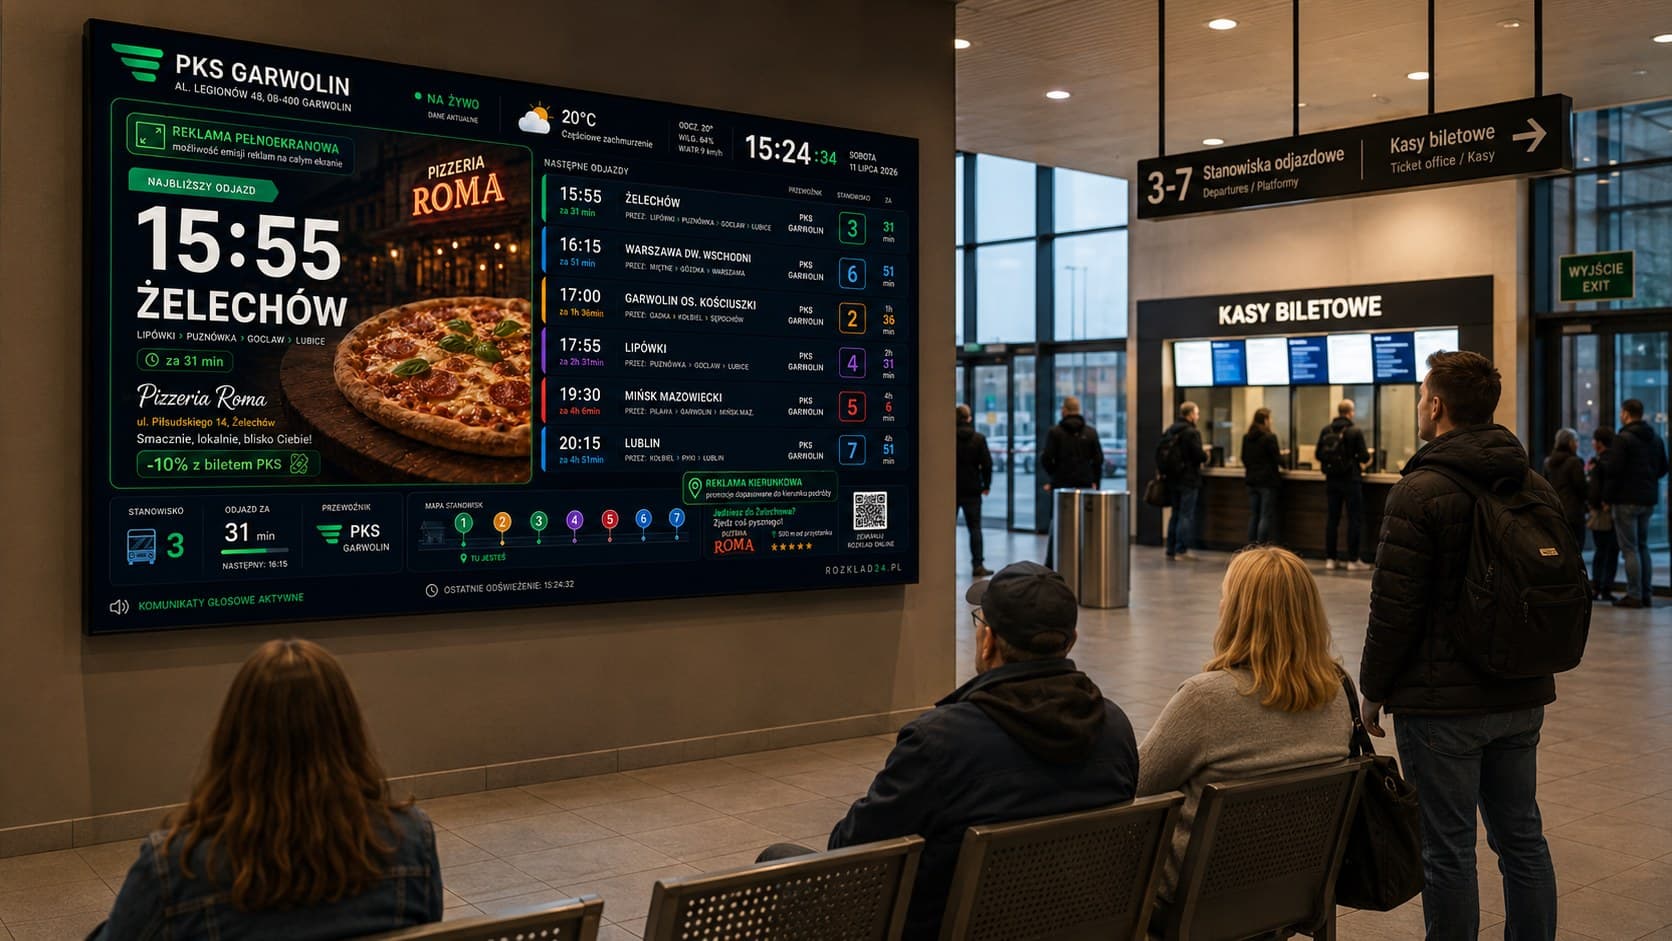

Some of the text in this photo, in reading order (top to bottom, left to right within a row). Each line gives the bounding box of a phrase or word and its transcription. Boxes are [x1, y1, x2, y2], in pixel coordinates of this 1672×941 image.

[176, 54, 350, 96] PKS GARWOLIN
[175, 82, 351, 112] AL. LEGIONÓW 48, 08-400 GARWOLIN
[427, 94, 479, 110] NA ŻYWO
[562, 110, 596, 127] 20°C
[173, 126, 339, 154] REKLAMA PEŁNOEKRANOWA
[562, 130, 653, 148] Częściowe zachmurzenie
[1390, 124, 1495, 156] Kasy biletowe
[221, 147, 245, 159] emisji
[247, 149, 275, 160] reklam
[277, 153, 287, 162] na
[849, 151, 876, 162] SOBOTA
[1390, 158, 1422, 174] Ticket
[1425, 153, 1456, 169] office
[1467, 148, 1495, 166] Kasy
[428, 155, 485, 179] PIZZERIA
[544, 159, 628, 175] NASTĘPNE ODJAZDY
[850, 163, 898, 177] 11 LIPCA 2026
[1203, 148, 1344, 181] Stanowiska odjazdowe
[148, 177, 256, 195] NAJBLIŻSZY ODJAZD
[1147, 166, 1193, 204] 3-7
[1203, 182, 1249, 199] Departures
[1257, 176, 1299, 192] Platformy
[412, 173, 505, 216] ROMA
[560, 186, 680, 208] 15:55 ŻELECHÓW
[560, 207, 595, 217] za 31 min
[800, 214, 812, 222] PKS
[848, 220, 857, 237] 3
[883, 222, 894, 232] 31
[137, 206, 341, 280] 15:55
[560, 238, 751, 263] 16:15 WARSZAWA DW. WSCHODNI
[570, 258, 579, 267] 51
[581, 259, 595, 268] min
[800, 261, 812, 269] PKS
[1569, 261, 1624, 278] WYJŚCIE
[848, 266, 857, 282] 6
[883, 266, 894, 276] 51
[1583, 280, 1610, 292] EXIT
[137, 280, 347, 327] ŻELECHÓW
[560, 288, 756, 310] 17:00 GARWOLIN OS. KOŚCIUSZKI
[800, 306, 813, 314] PKS
[1219, 295, 1382, 325] KASY BILETOWE
[848, 310, 857, 327] 2
[883, 315, 895, 325] 36
[137, 329, 175, 340] LIPÓWKI
[296, 336, 325, 346] LUBICE
[560, 338, 667, 353] 17:55 LIPÓWKI
[166, 356, 224, 367] za 31 min
[848, 355, 858, 372] 4
[883, 359, 894, 368] 31
[137, 382, 267, 410] Pizzeria Roma
[560, 387, 722, 402] 19:30 MIŃSK MAZOWIECKI
[848, 399, 857, 415] 5
[885, 402, 892, 412] 6
[137, 416, 275, 429] ul. Piłsudskiego 14, Żelechów
[137, 434, 312, 445] Smacznie, lokalnie, blisko Ciebie!
[560, 436, 660, 450] 20:15 LUBLIN
[848, 442, 857, 458] 7
[883, 444, 894, 454] 51
[147, 457, 282, 471] -10% z biletem PKS
[706, 478, 802, 487] REKLAMA KIERUNKOWA
[128, 507, 184, 516] STANOWISKO
[225, 506, 258, 514] ODJAZD
[322, 503, 370, 512] PRZEWOŹNIK
[461, 518, 465, 527] 1
[500, 517, 506, 527] 2
[536, 516, 542, 526] 3
[572, 516, 578, 525] 4
[607, 515, 613, 524] 5
[641, 513, 646, 523] 6
[674, 513, 680, 522] 7
[225, 522, 275, 542] 31 min
[350, 524, 380, 538] PKS
[167, 533, 184, 558] 3
[343, 543, 390, 552] GARWOLIN
[714, 539, 754, 554] ROMA
[222, 560, 288, 570] NASTĘPNY: 16:15
[444, 585, 483, 594] OSTATNIE
[486, 582, 541, 592] ODŚWIEŻENIE:
[139, 593, 304, 610] KOMUNIKATY GŁOSOWE AKTYWNE
